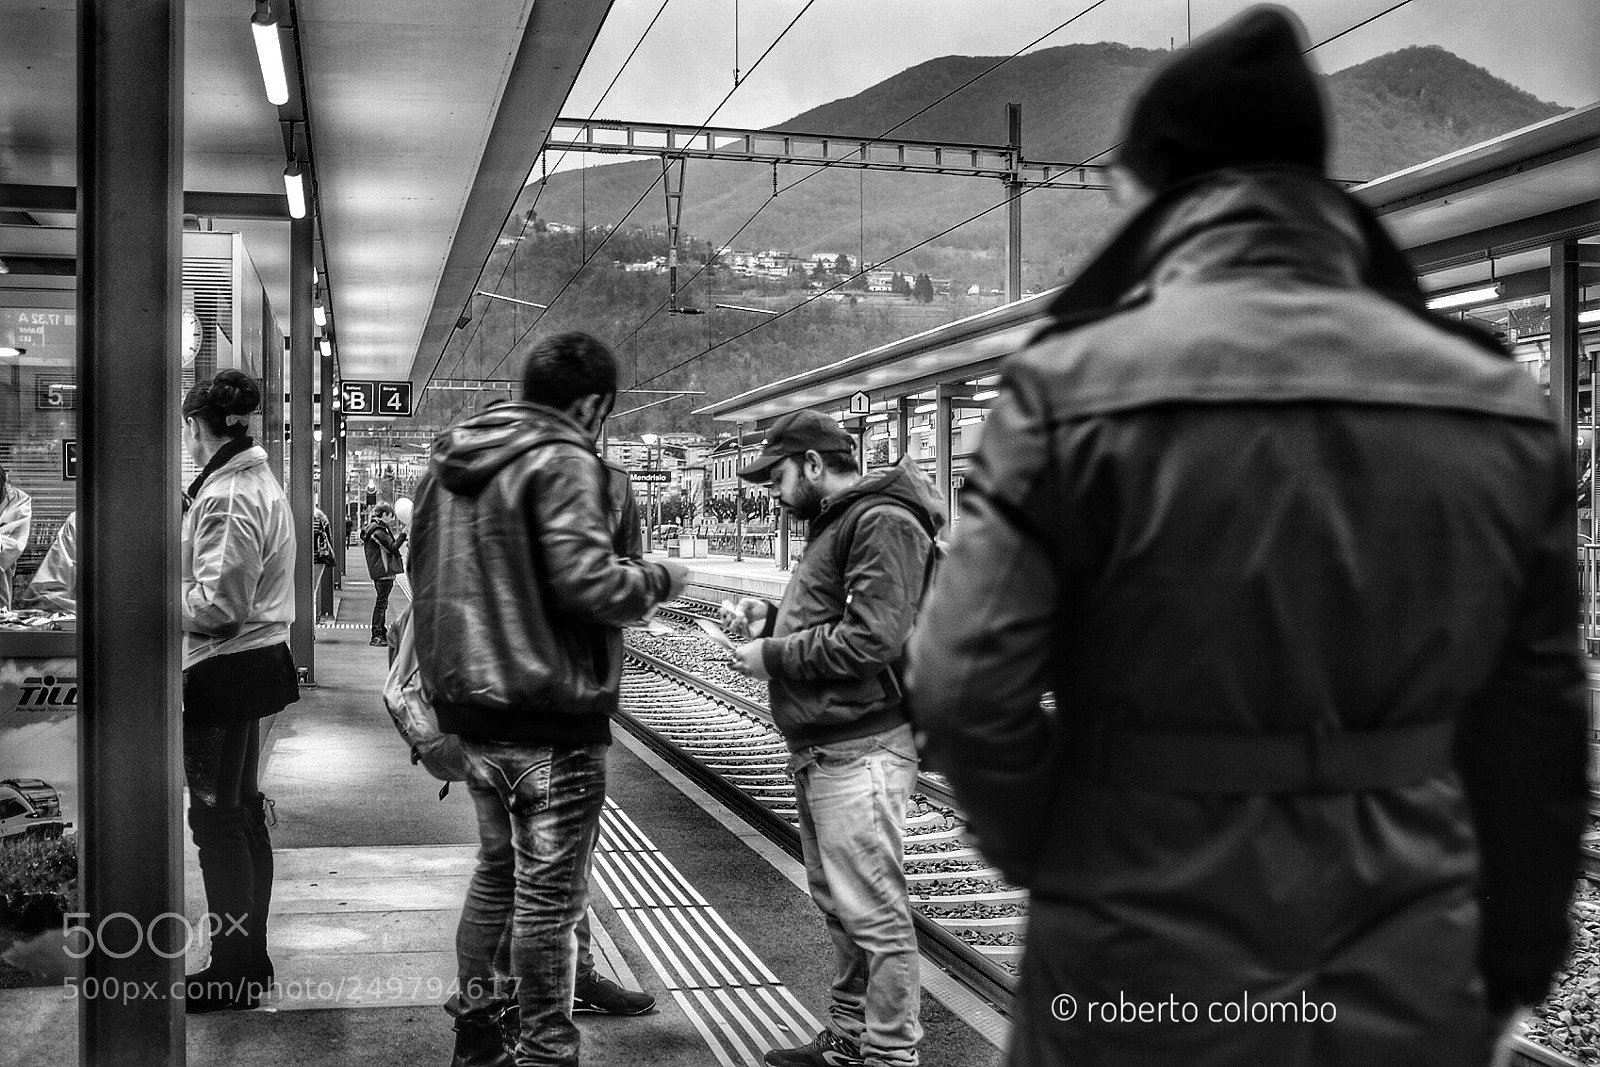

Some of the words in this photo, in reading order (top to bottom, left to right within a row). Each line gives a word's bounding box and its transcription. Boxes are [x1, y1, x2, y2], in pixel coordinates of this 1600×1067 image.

[350, 391, 366, 410] B
[386, 392, 402, 411] 4
[630, 473, 667, 482] Mendrisio
